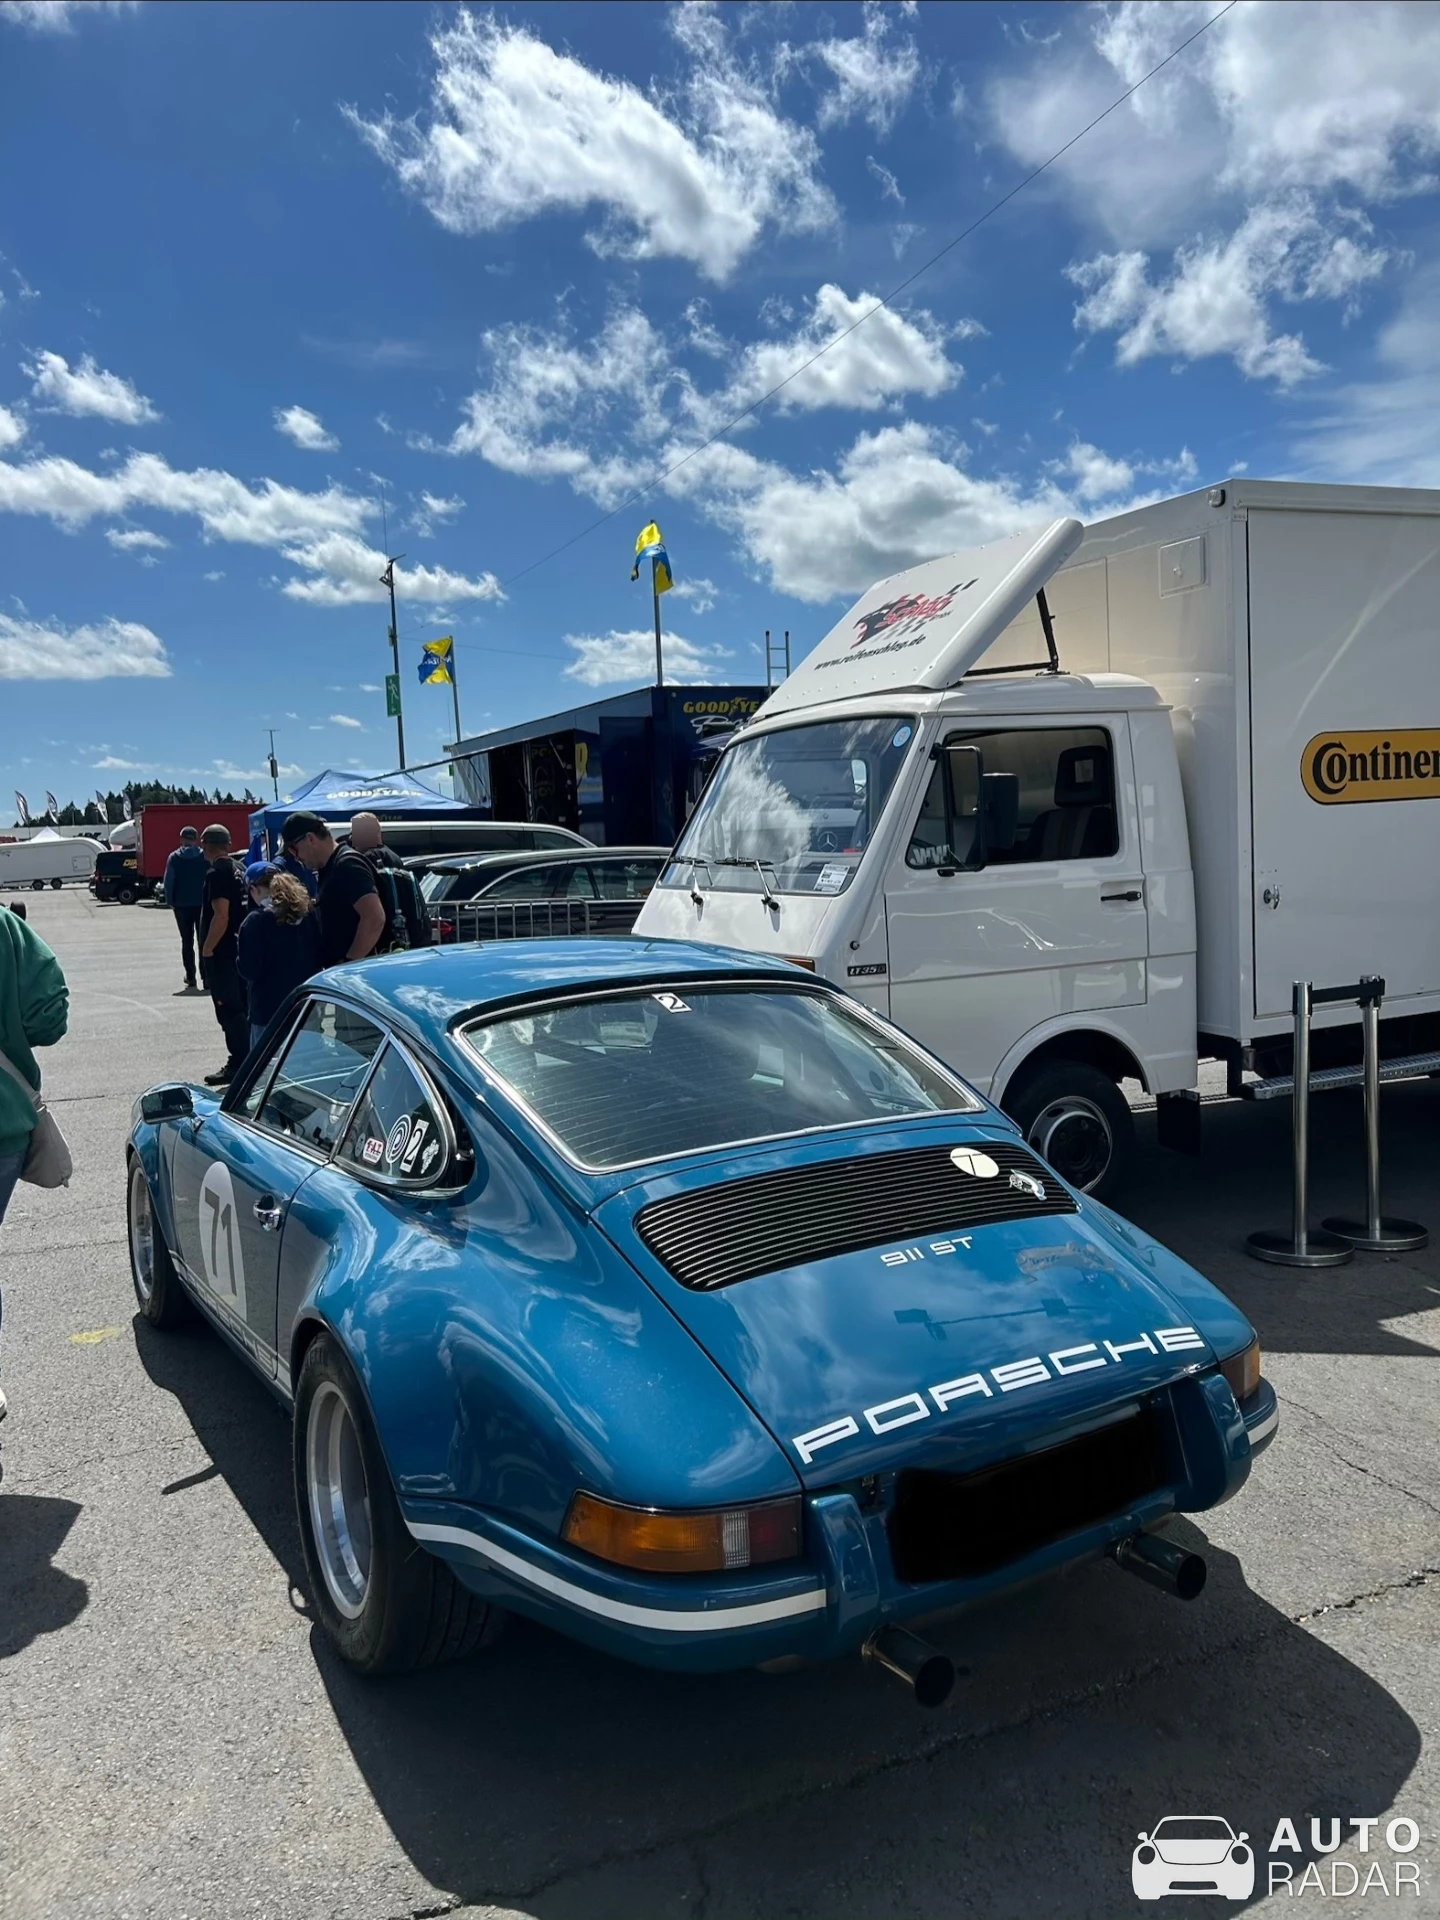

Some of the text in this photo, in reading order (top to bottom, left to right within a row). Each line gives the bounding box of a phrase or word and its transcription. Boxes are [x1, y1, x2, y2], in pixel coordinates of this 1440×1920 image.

[814, 634, 926, 670] www.reifenschlag.de
[327, 788, 421, 798] GOODYEAR
[658, 995, 686, 1010] 2
[403, 1128, 423, 1166] 2
[205, 1186, 238, 1298] 71
[880, 1236, 973, 1267] 911 ST
[792, 1326, 1206, 1464] PORSCHE
